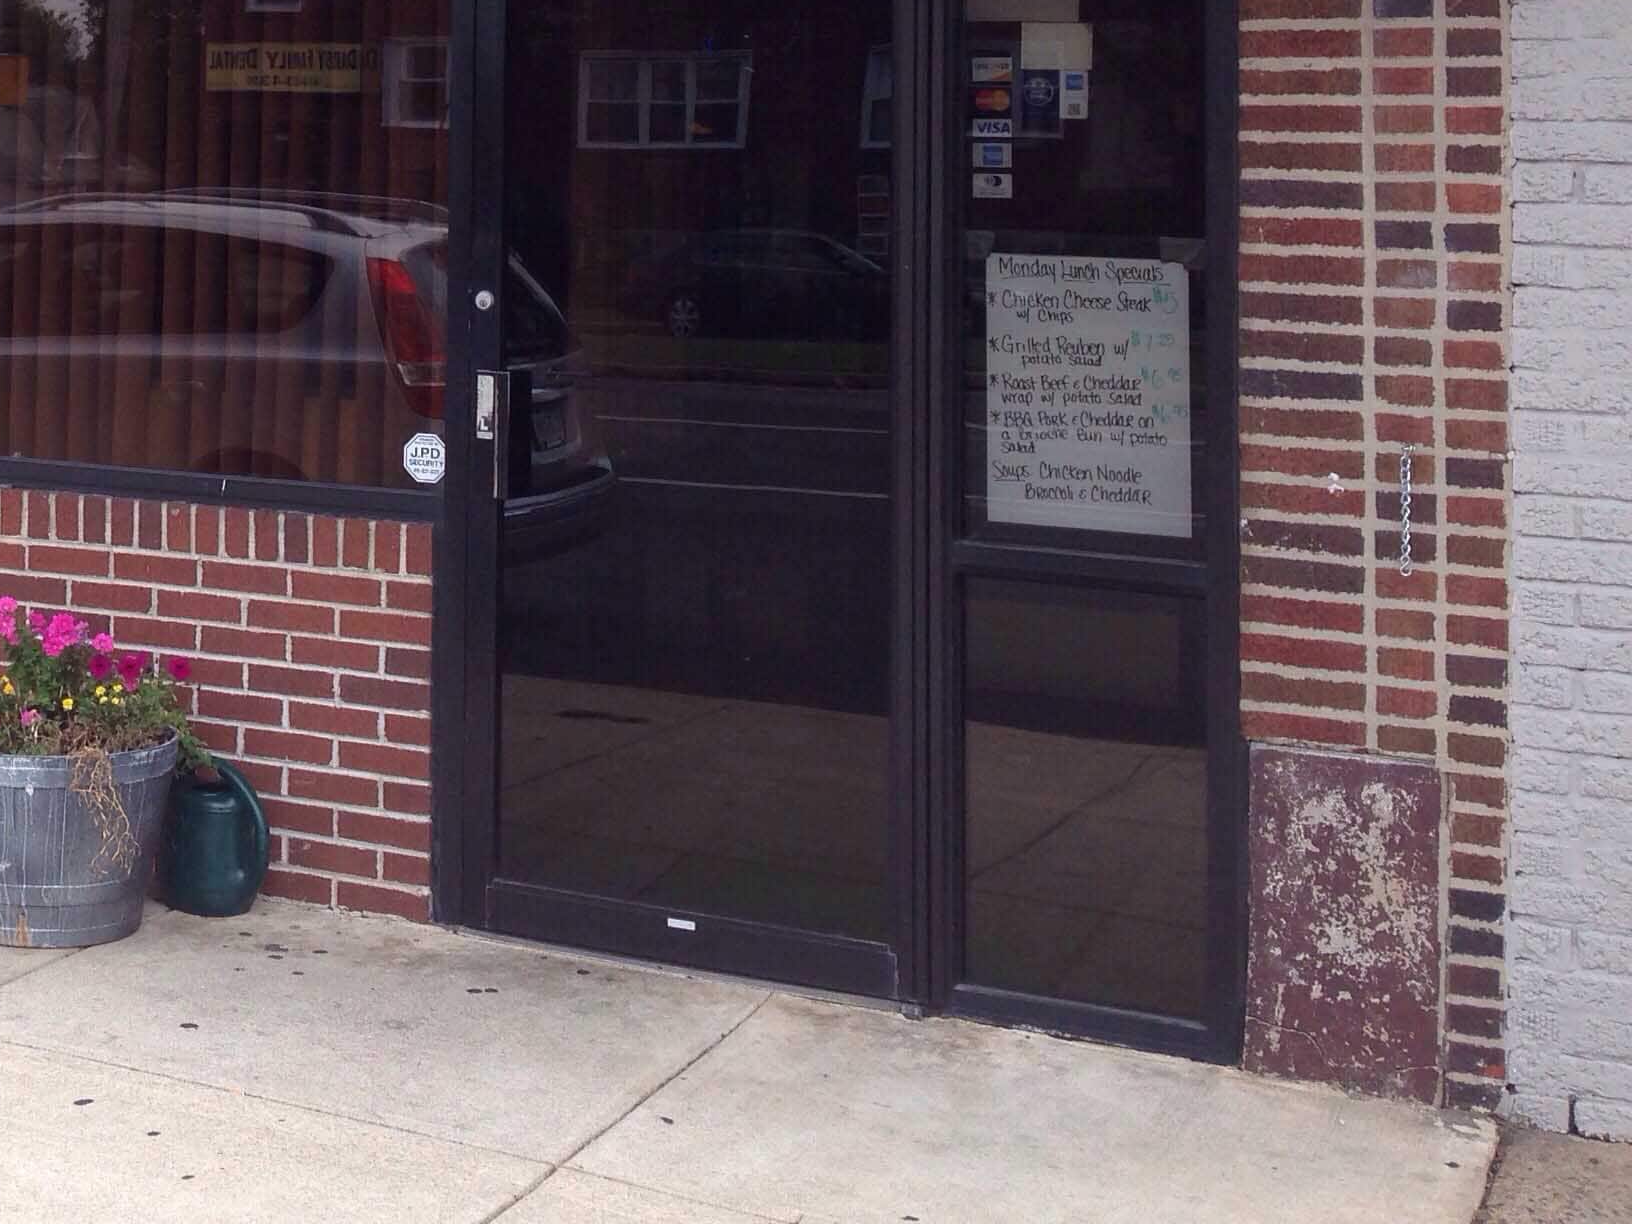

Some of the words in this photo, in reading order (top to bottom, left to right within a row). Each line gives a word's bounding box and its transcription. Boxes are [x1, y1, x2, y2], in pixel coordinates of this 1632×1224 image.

[976, 121, 1011, 135] VISA
[998, 256, 1056, 284] Monday
[1061, 260, 1100, 282] Lunch
[1105, 261, 1165, 285] Specials
[1002, 289, 1060, 310] Chicken
[1063, 289, 1112, 310] Cheese
[1116, 291, 1152, 312] Steak
[1038, 309, 1074, 324] Chips
[1002, 334, 1051, 353] Grilled
[1056, 335, 1105, 356] Reuben
[1022, 354, 1062, 369] potato
[1002, 375, 1037, 390] Roast
[1041, 375, 1069, 390] Beef
[1063, 393, 1102, 407] potato
[1130, 433, 1168, 447] potato
[1039, 461, 1094, 479] Chicken
[1097, 465, 1143, 484] Noodle
